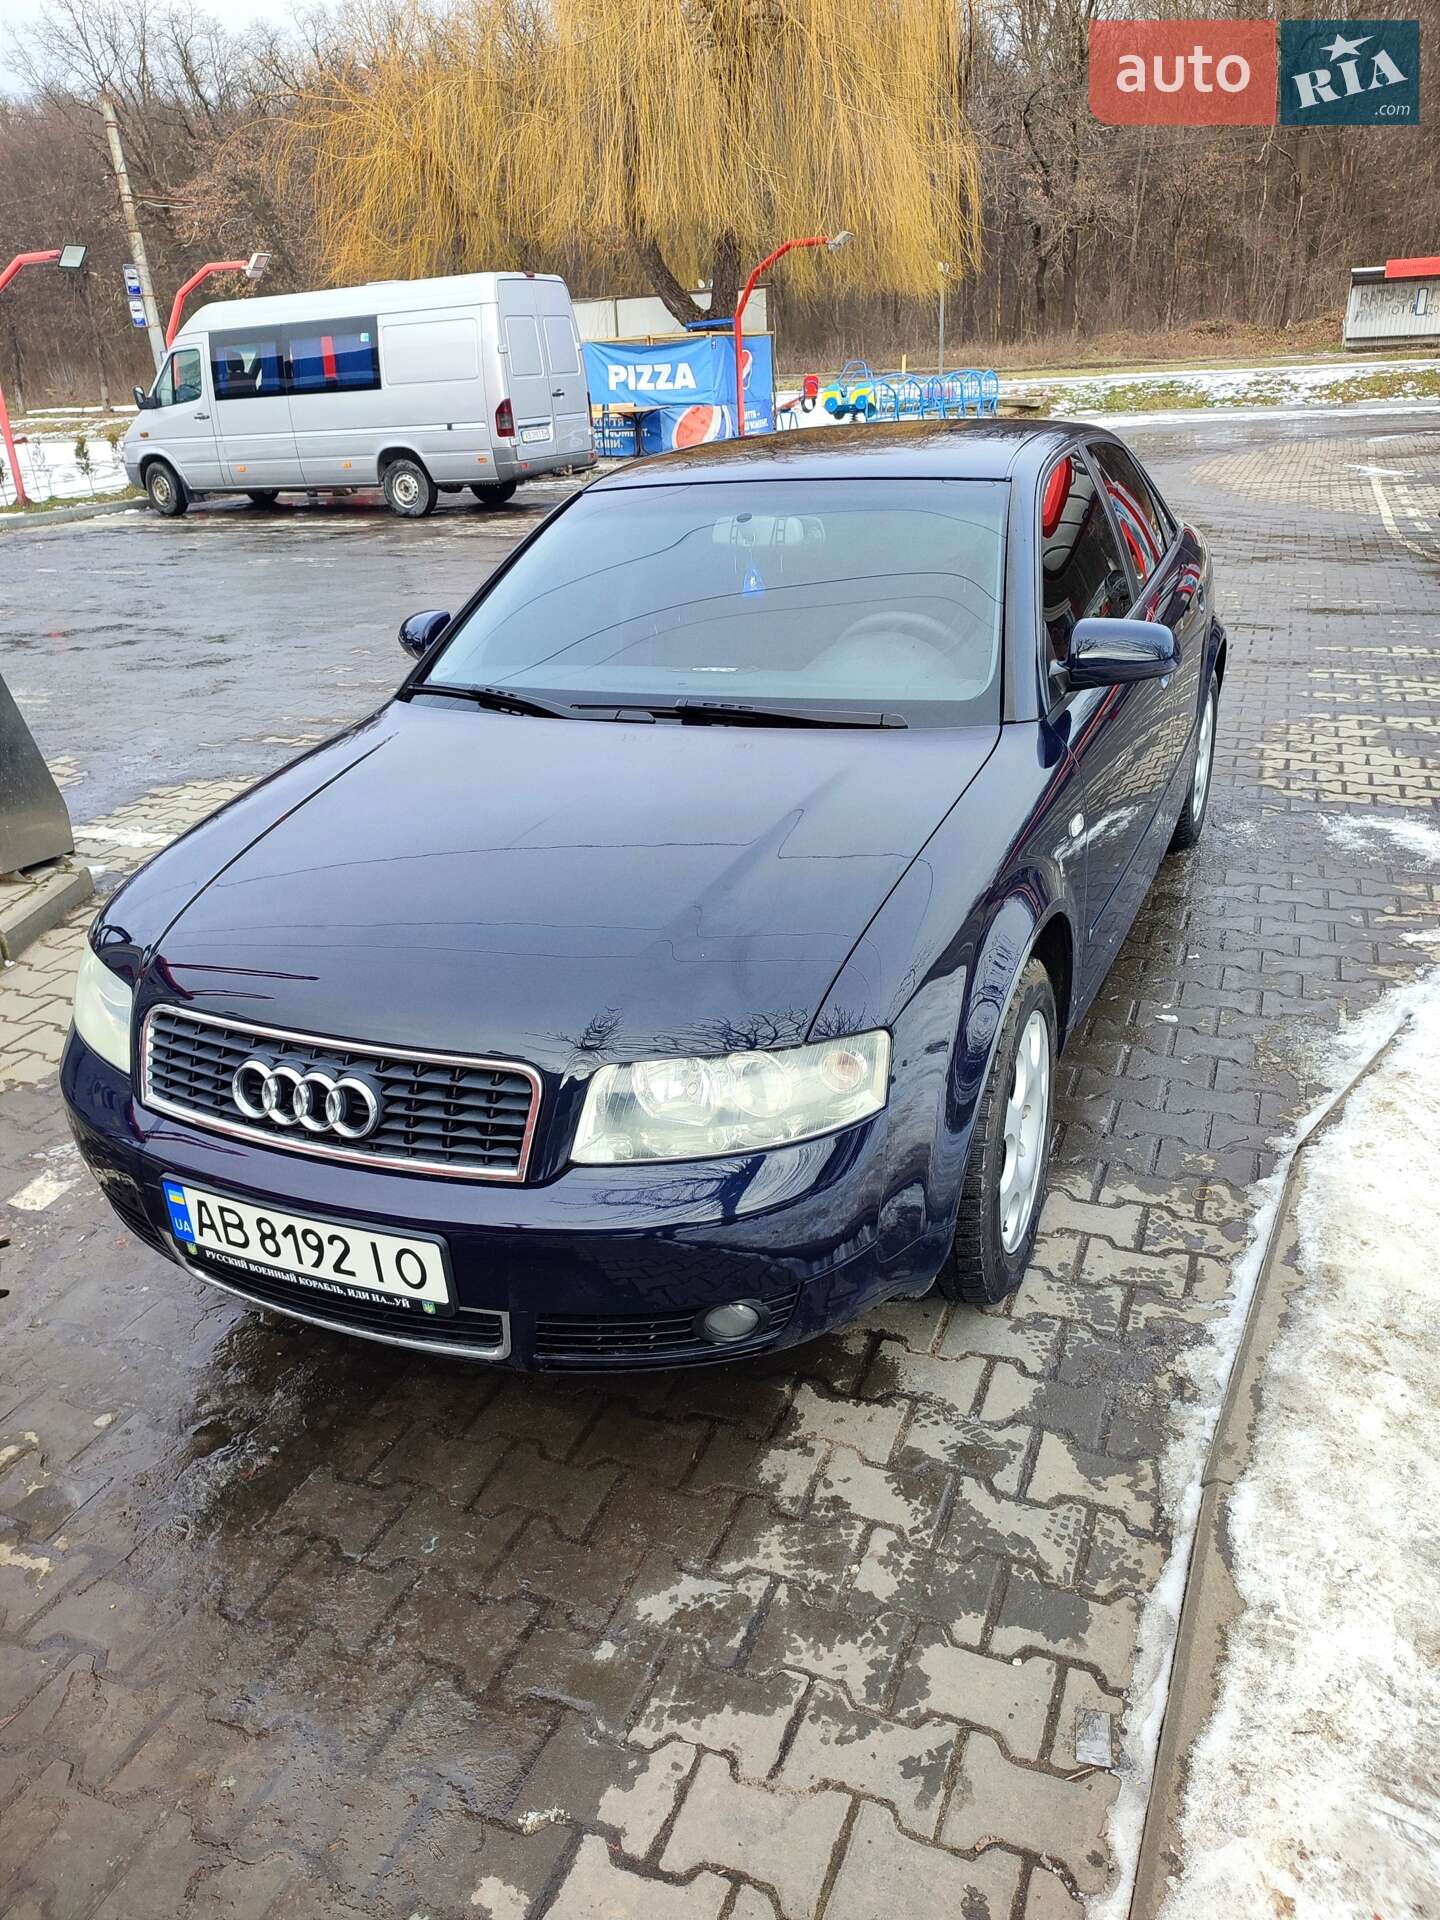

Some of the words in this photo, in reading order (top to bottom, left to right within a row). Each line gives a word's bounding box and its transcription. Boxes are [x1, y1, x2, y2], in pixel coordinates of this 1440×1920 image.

[607, 363, 697, 391] PIZZA
[175, 1220, 192, 1233] UA
[256, 1216, 356, 1277] 8192
[205, 1249, 248, 1269] РУССКИЙ
[249, 1263, 297, 1283] ВОЕННЫЙ
[299, 1276, 347, 1296] КОРАБЛЬ,
[347, 1288, 370, 1300] ИДИ
